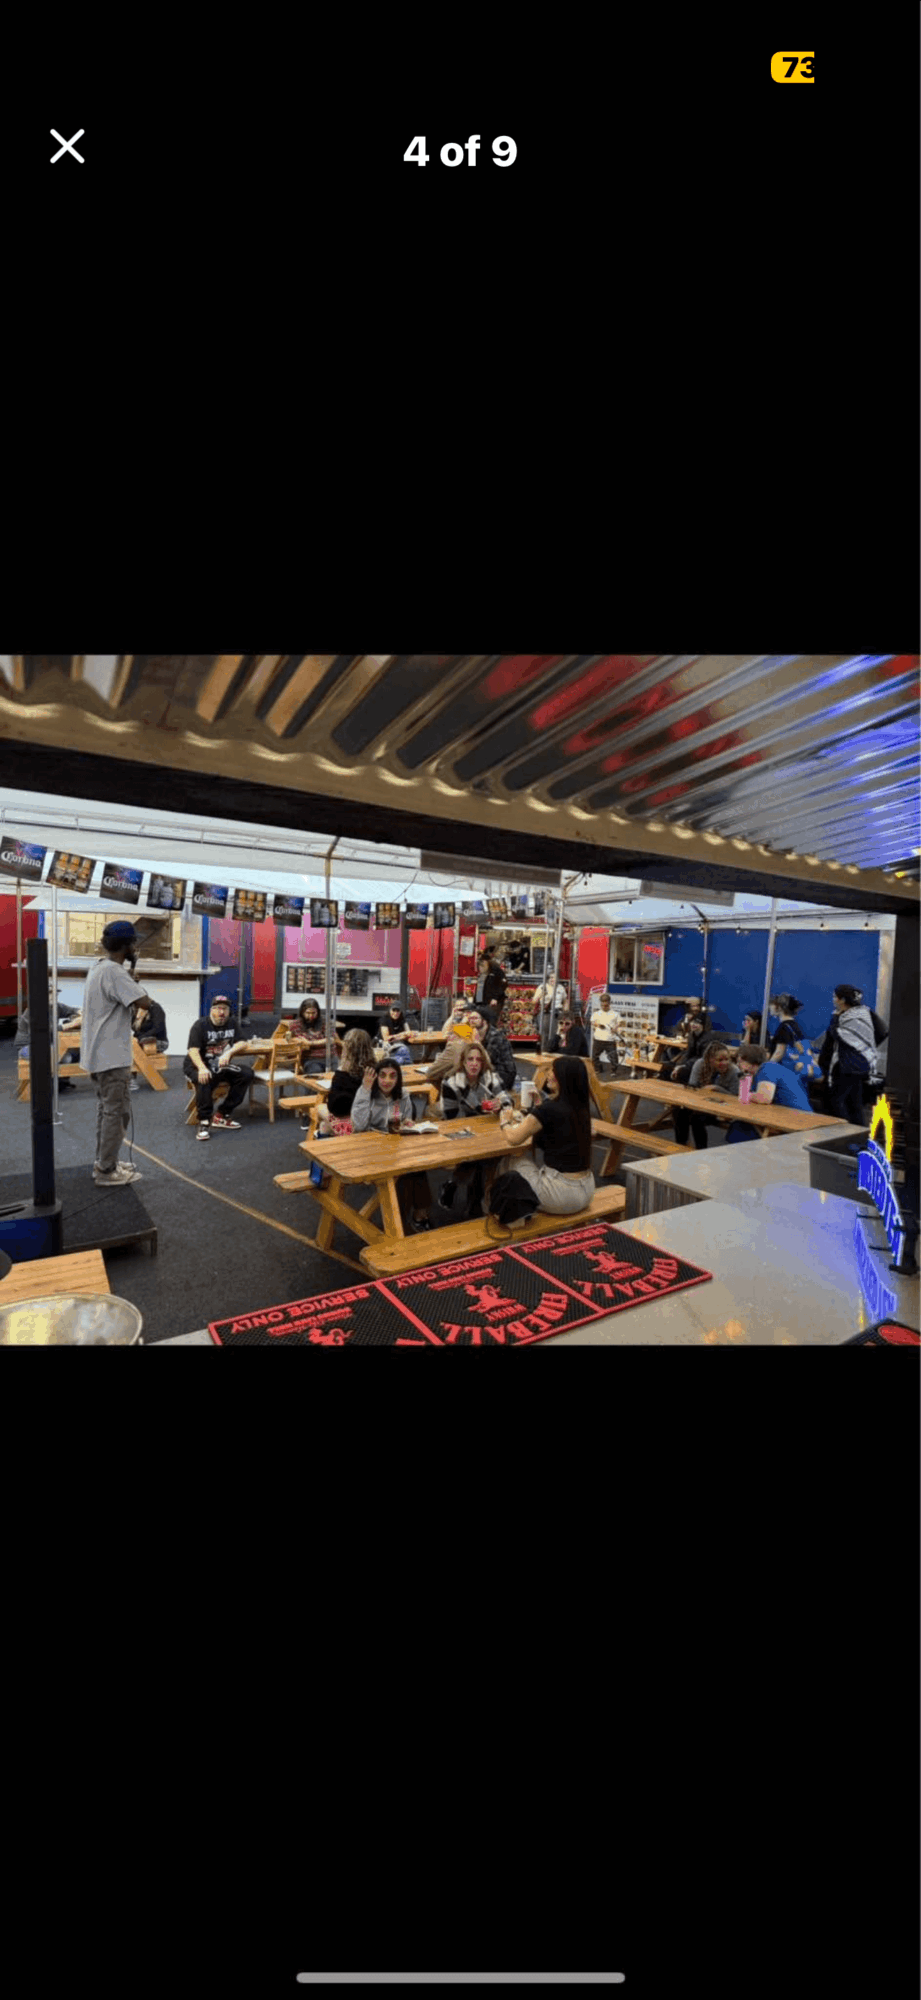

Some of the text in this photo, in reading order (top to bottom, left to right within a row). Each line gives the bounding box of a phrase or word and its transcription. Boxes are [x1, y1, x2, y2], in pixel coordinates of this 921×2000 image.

[1, 851, 41, 867] Corona
[103, 875, 138, 891] Corona
[436, 1253, 503, 1277] SERVICE
[395, 1271, 437, 1289] ONLY
[572, 1257, 678, 1299] FIREBALL
[286, 1288, 371, 1317] SERVICE
[231, 1310, 284, 1334] ONLY
[440, 1291, 569, 1345] FIREBALL
